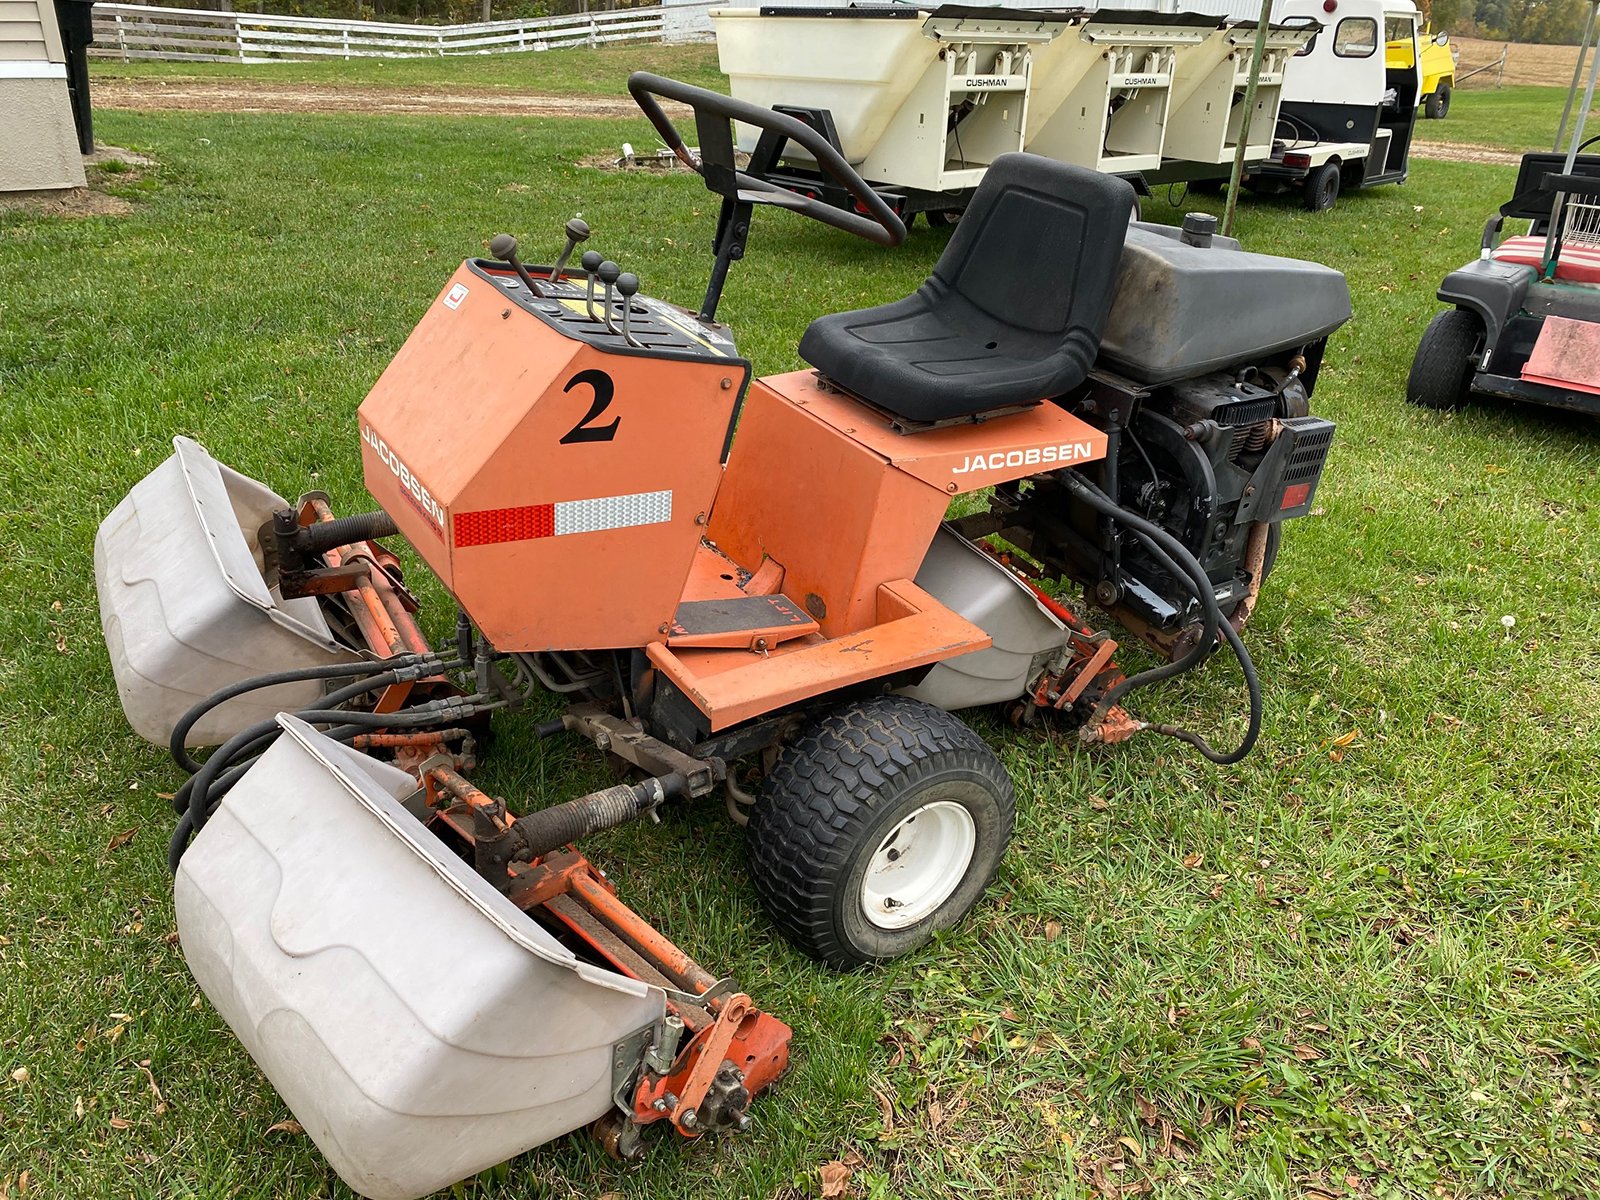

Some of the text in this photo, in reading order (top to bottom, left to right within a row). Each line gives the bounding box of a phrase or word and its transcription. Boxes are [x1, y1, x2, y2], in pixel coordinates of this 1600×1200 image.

[966, 79, 1008, 87] CUSHMAN
[559, 369, 621, 444] 2
[952, 442, 1092, 474] JACOBSEN
[361, 425, 445, 528] JACOBSEN
[767, 599, 801, 622] LIFT
